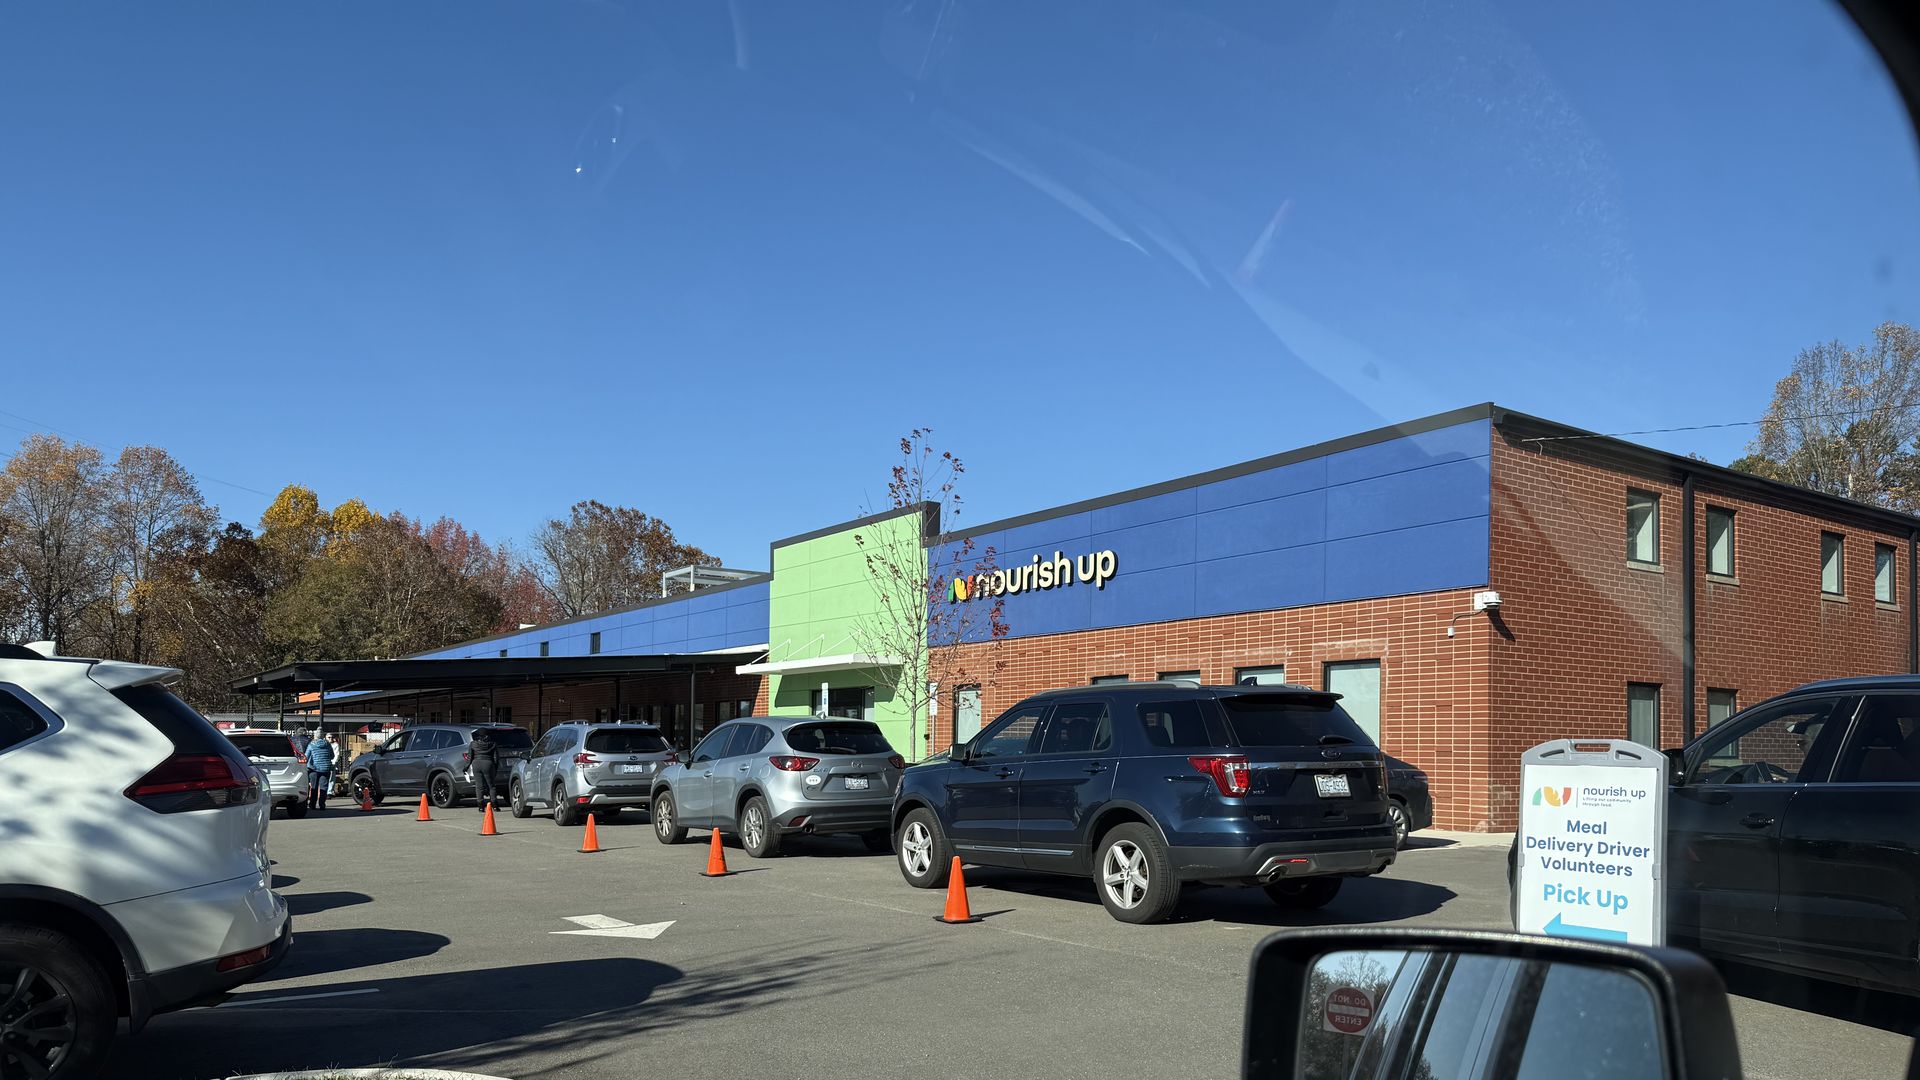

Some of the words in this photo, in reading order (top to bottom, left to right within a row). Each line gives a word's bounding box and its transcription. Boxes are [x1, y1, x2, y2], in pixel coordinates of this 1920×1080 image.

[975, 551, 1072, 598] nourish
[1077, 549, 1117, 588] up
[1583, 786, 1627, 797] nourish
[1631, 789, 1646, 800] up
[1566, 820, 1607, 835] Meal
[1526, 836, 1594, 858] Delivery
[1597, 841, 1650, 858] Driver
[1541, 856, 1633, 877] Volunteers
[1543, 883, 1591, 906] Pick
[1597, 889, 1629, 915] Up
